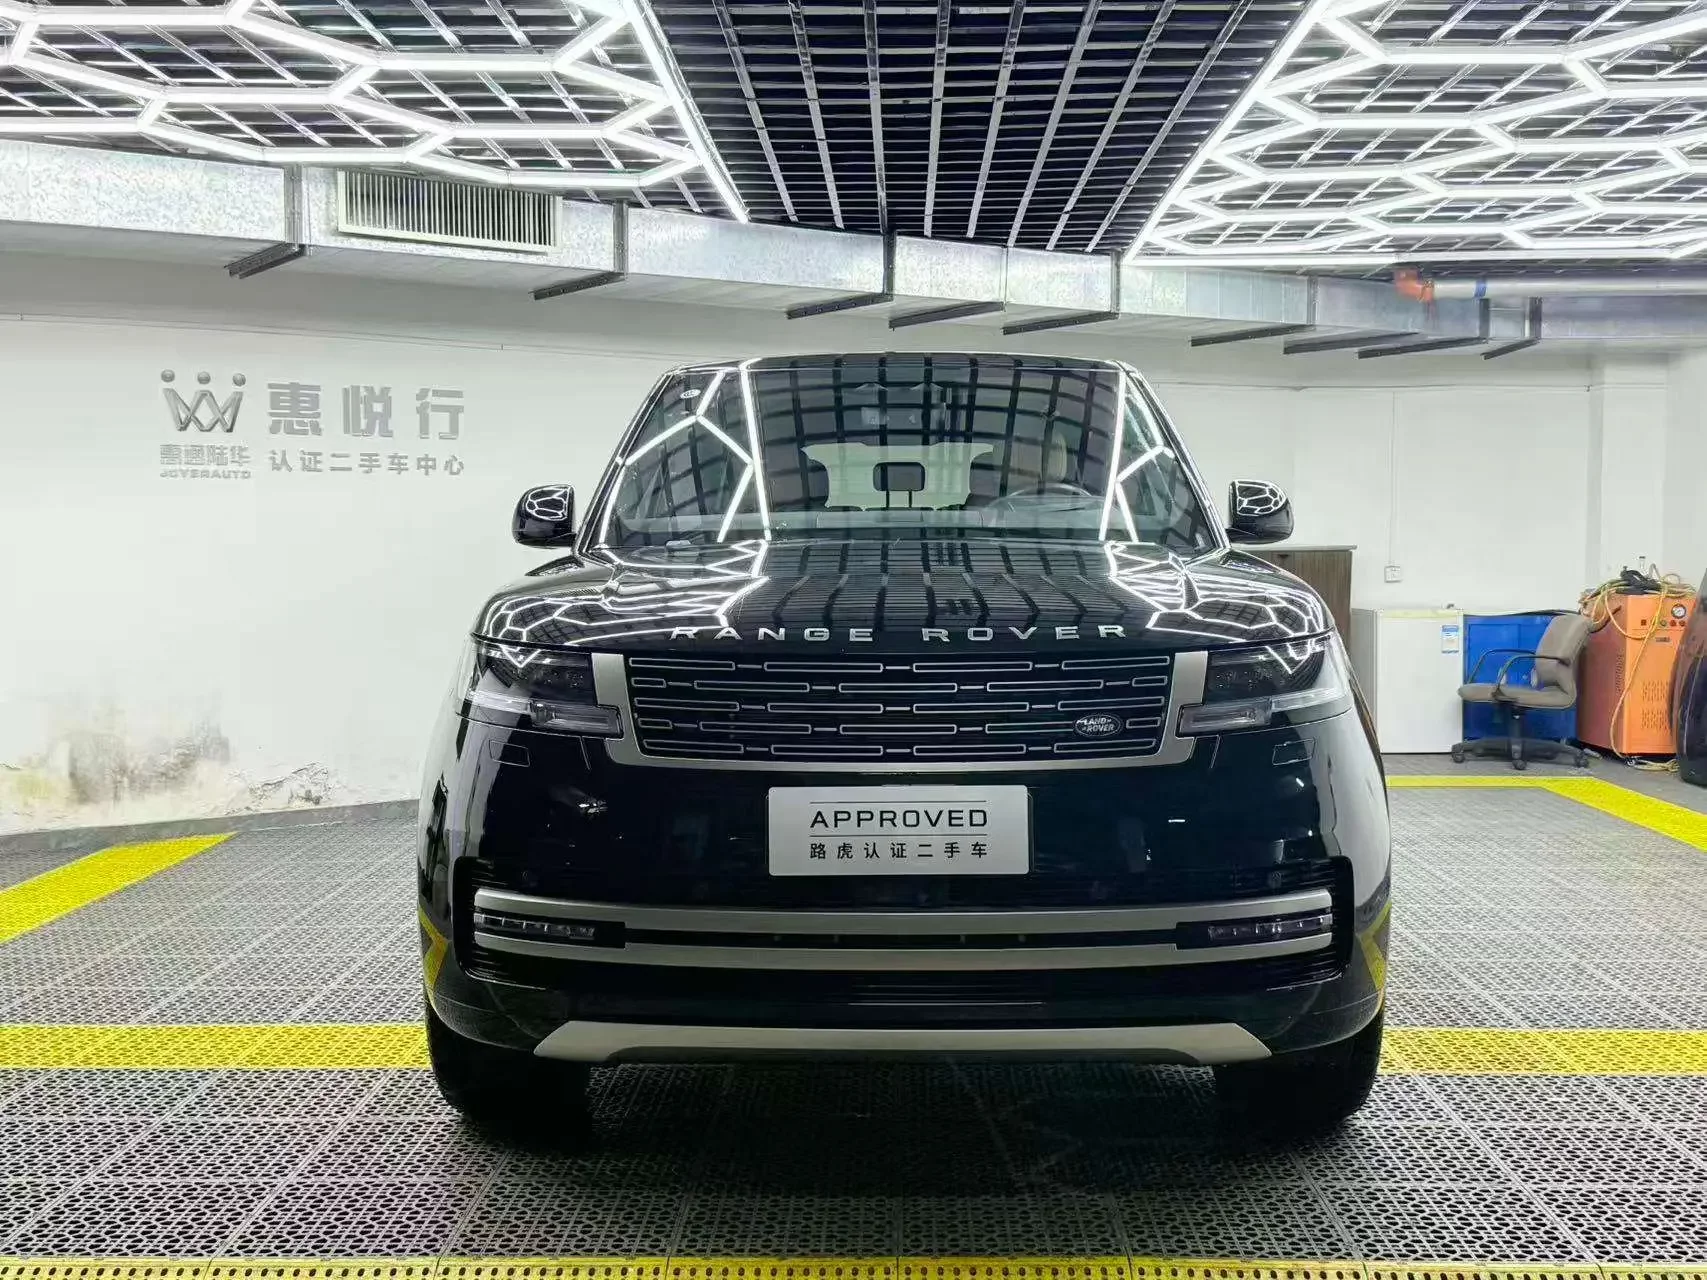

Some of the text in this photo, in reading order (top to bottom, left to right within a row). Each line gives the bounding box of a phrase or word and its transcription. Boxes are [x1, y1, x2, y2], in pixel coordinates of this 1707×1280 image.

[267, 382, 465, 440] 惠悦行
[269, 449, 465, 476] 认证二手车中心
[670, 624, 1127, 642] RANGE ROVER
[1086, 723, 1115, 732] ROVER
[809, 809, 988, 829] APPROVED
[810, 842, 988, 859] 路虎认证二手车
